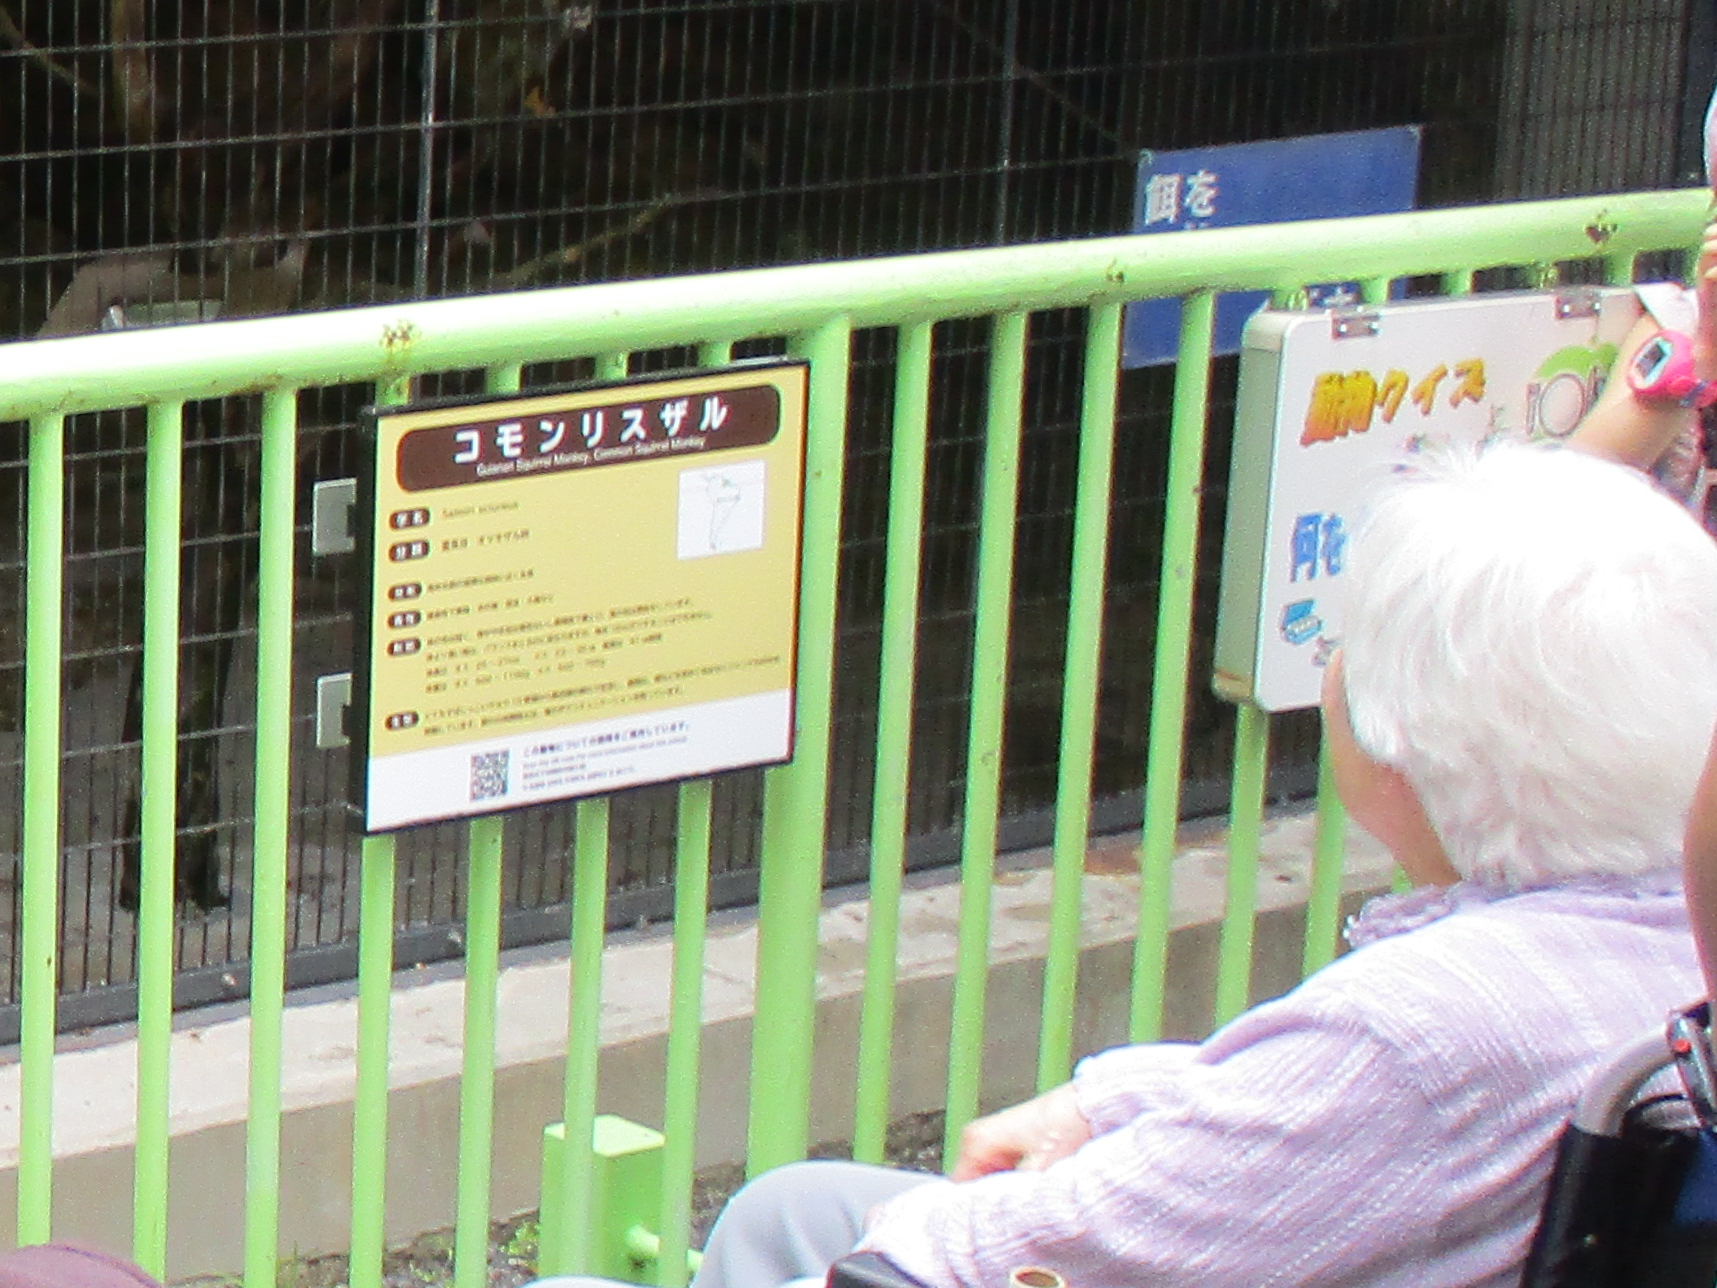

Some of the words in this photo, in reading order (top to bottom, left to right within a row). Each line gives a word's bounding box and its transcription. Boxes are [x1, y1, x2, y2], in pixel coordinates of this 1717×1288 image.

[1145, 169, 1220, 226] 餌を
[453, 396, 729, 464] コモンリスザル
